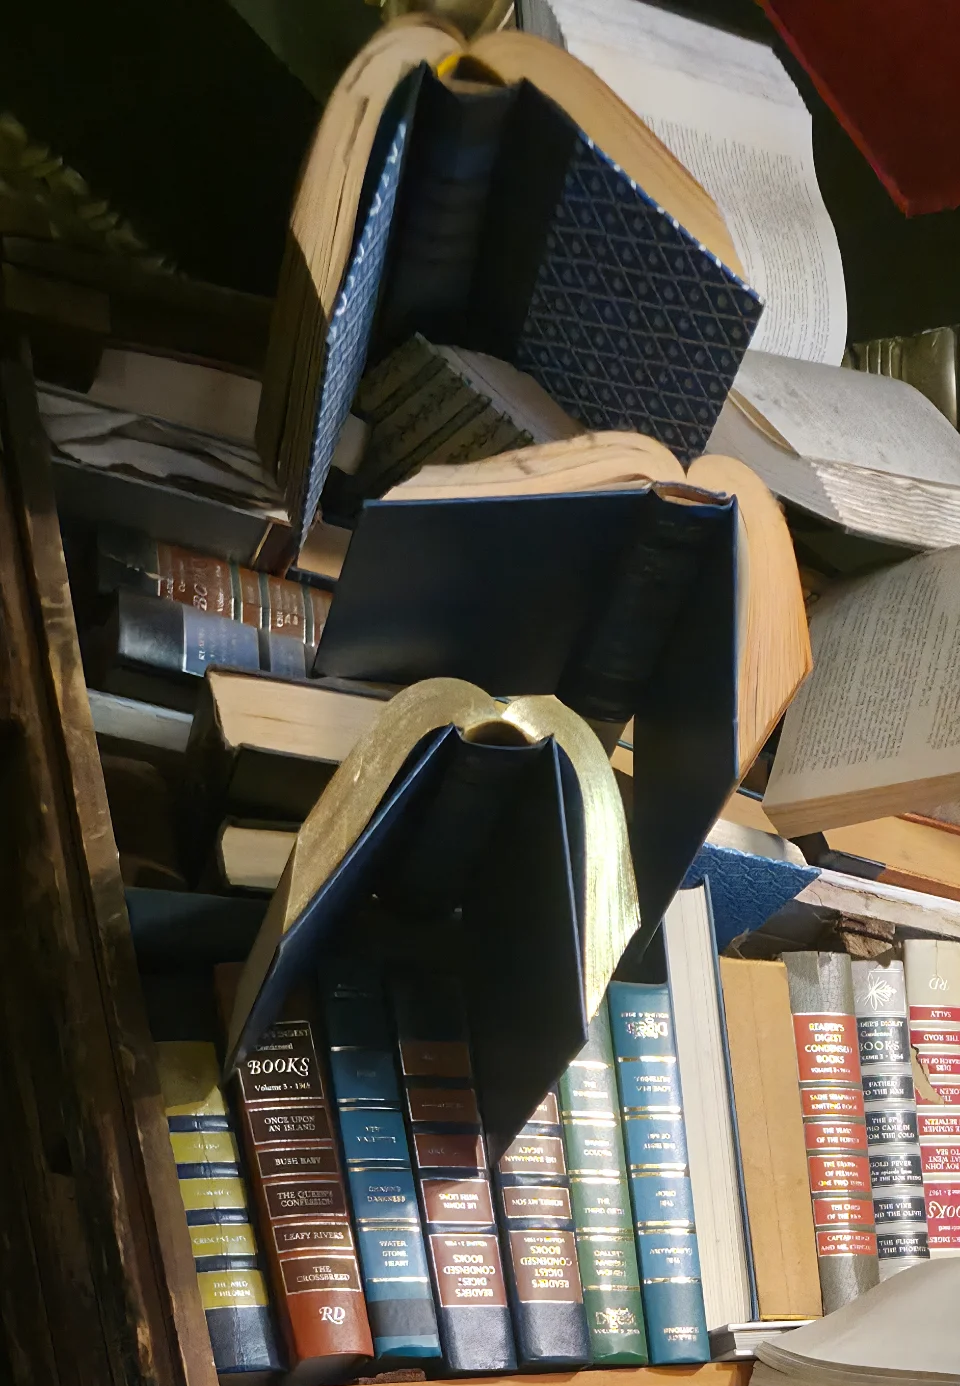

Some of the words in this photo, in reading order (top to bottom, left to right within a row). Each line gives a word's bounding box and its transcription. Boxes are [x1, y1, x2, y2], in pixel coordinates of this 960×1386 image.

[809, 1023, 844, 1032] READER'S
[815, 1034, 841, 1042] DIGEST
[816, 1055, 844, 1064] BOOKS
[248, 1058, 309, 1076] BOOKS
[530, 1246, 561, 1254] BOOKS
[453, 1255, 483, 1263] BOOKS
[532, 1280, 569, 1288] READER'S
[319, 1307, 345, 1324] RD
